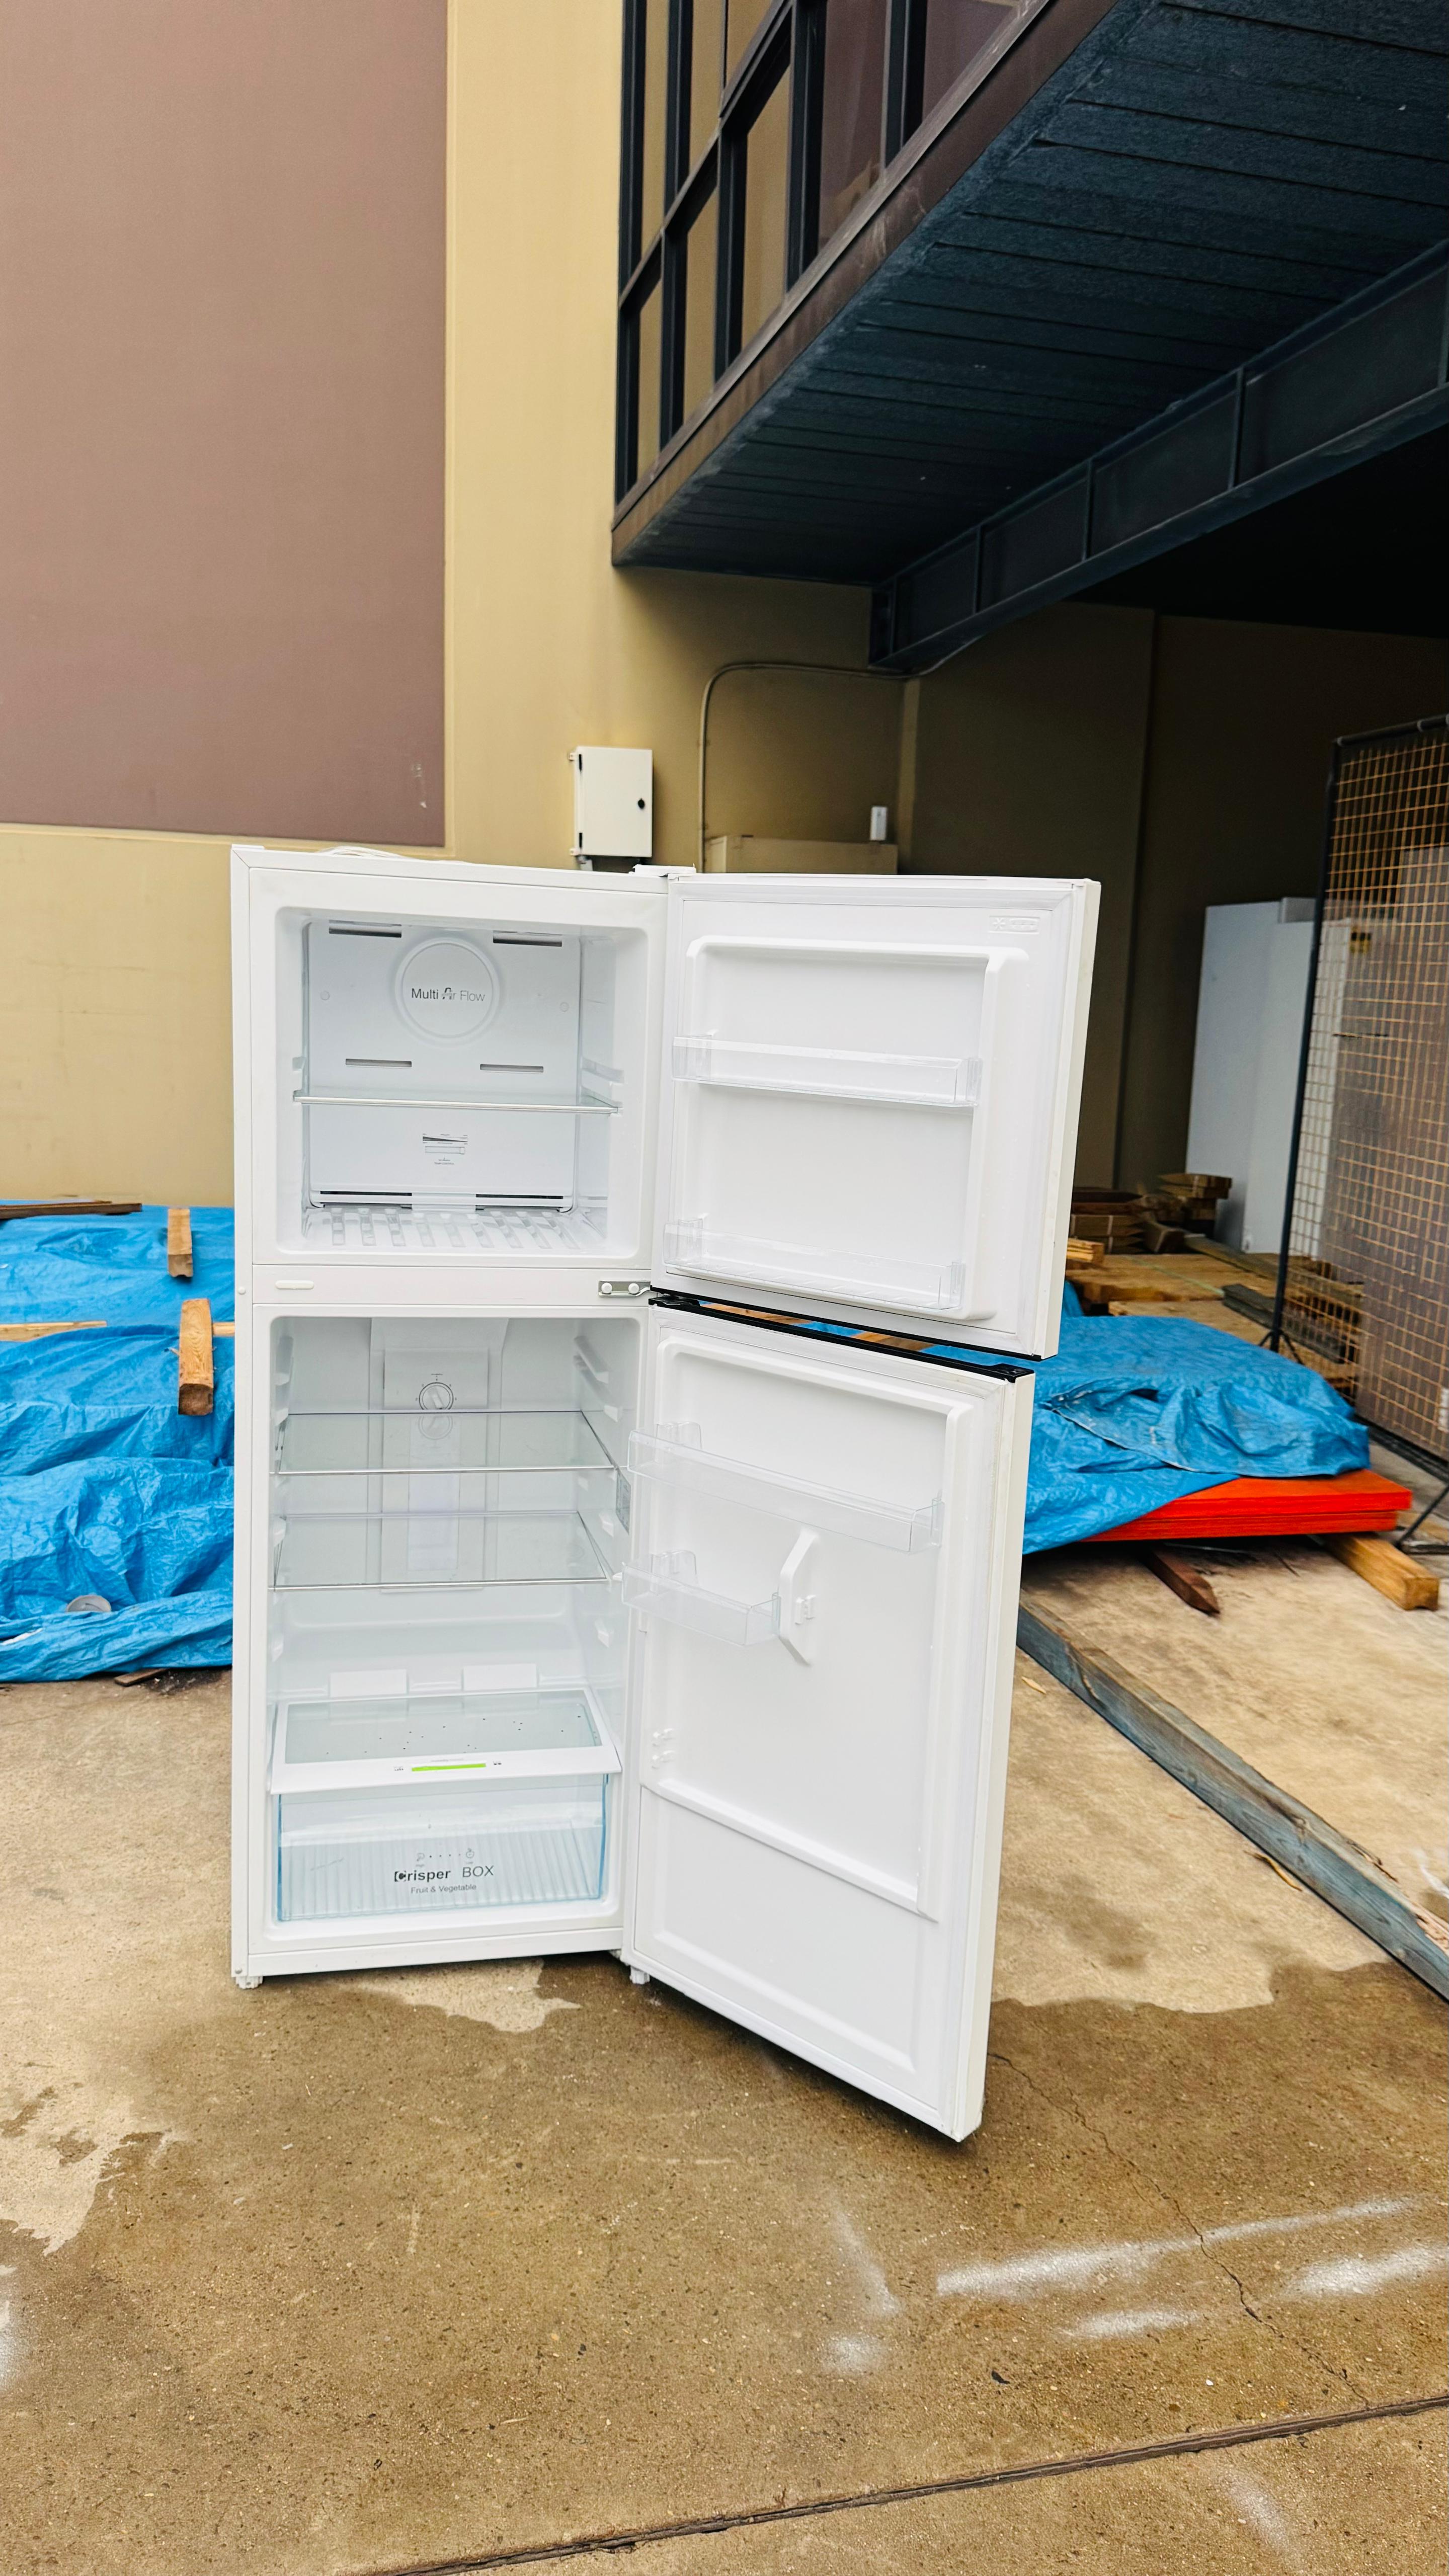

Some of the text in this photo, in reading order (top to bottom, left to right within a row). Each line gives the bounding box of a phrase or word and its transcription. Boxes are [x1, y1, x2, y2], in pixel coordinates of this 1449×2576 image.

[411, 987, 486, 1002] Multi Air Flow
[394, 1865, 494, 1883] Crisper BOX
[439, 1884, 477, 1893] Vegetable
